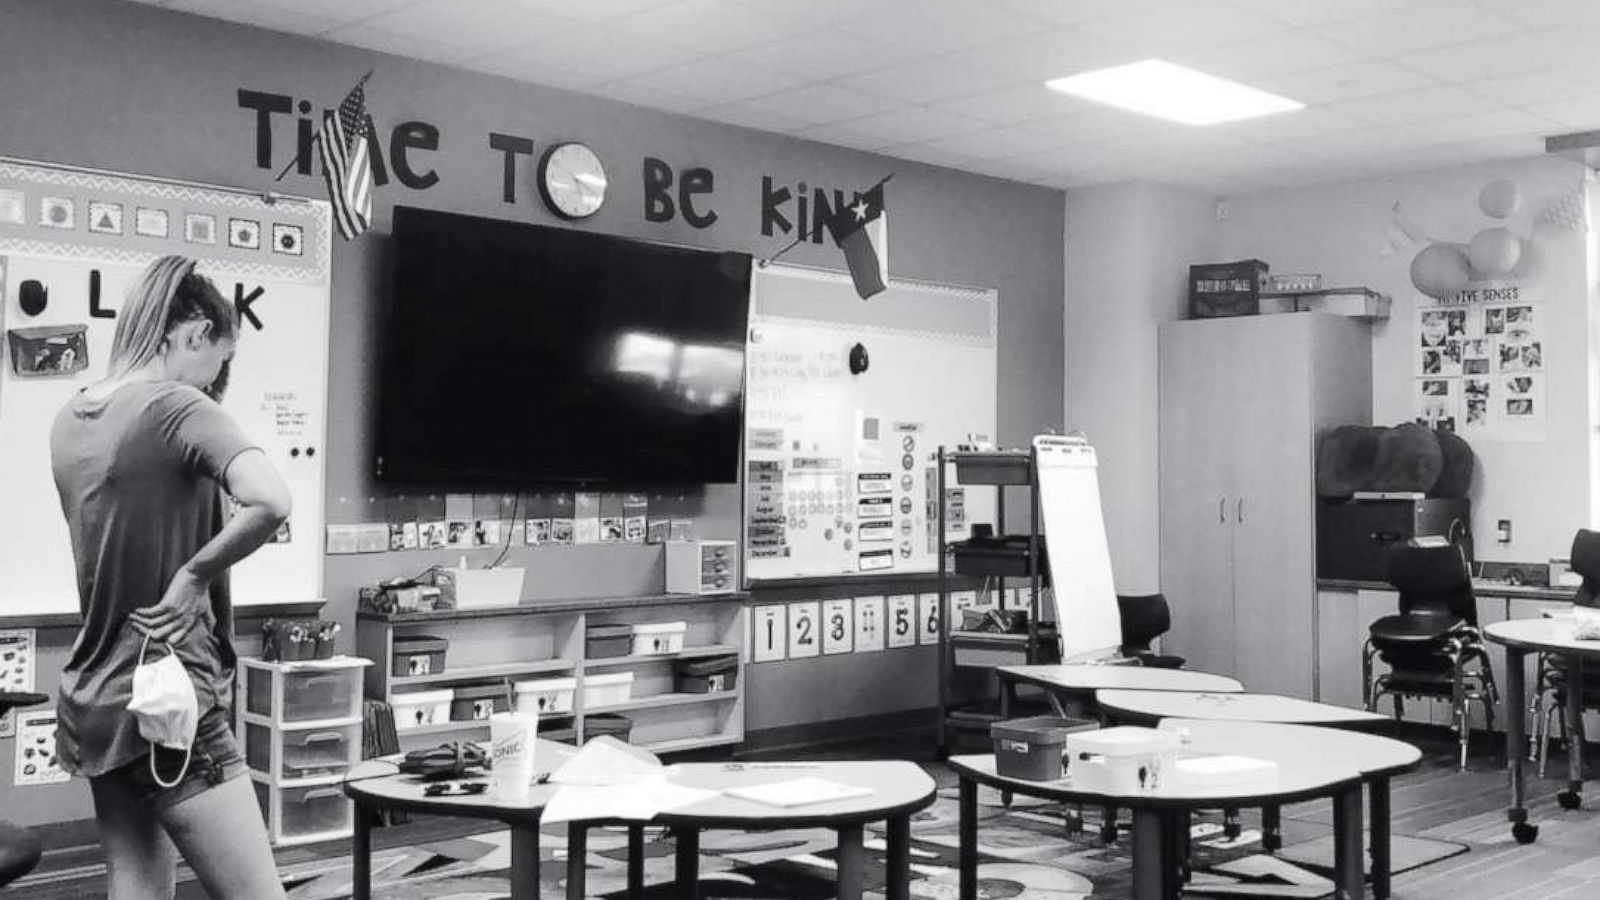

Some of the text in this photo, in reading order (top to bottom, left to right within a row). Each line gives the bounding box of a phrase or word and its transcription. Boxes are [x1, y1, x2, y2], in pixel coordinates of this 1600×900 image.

[644, 157, 718, 229] Be
[796, 615, 813, 645] 2
[831, 613, 845, 641] 3
[896, 607, 909, 636] 5
